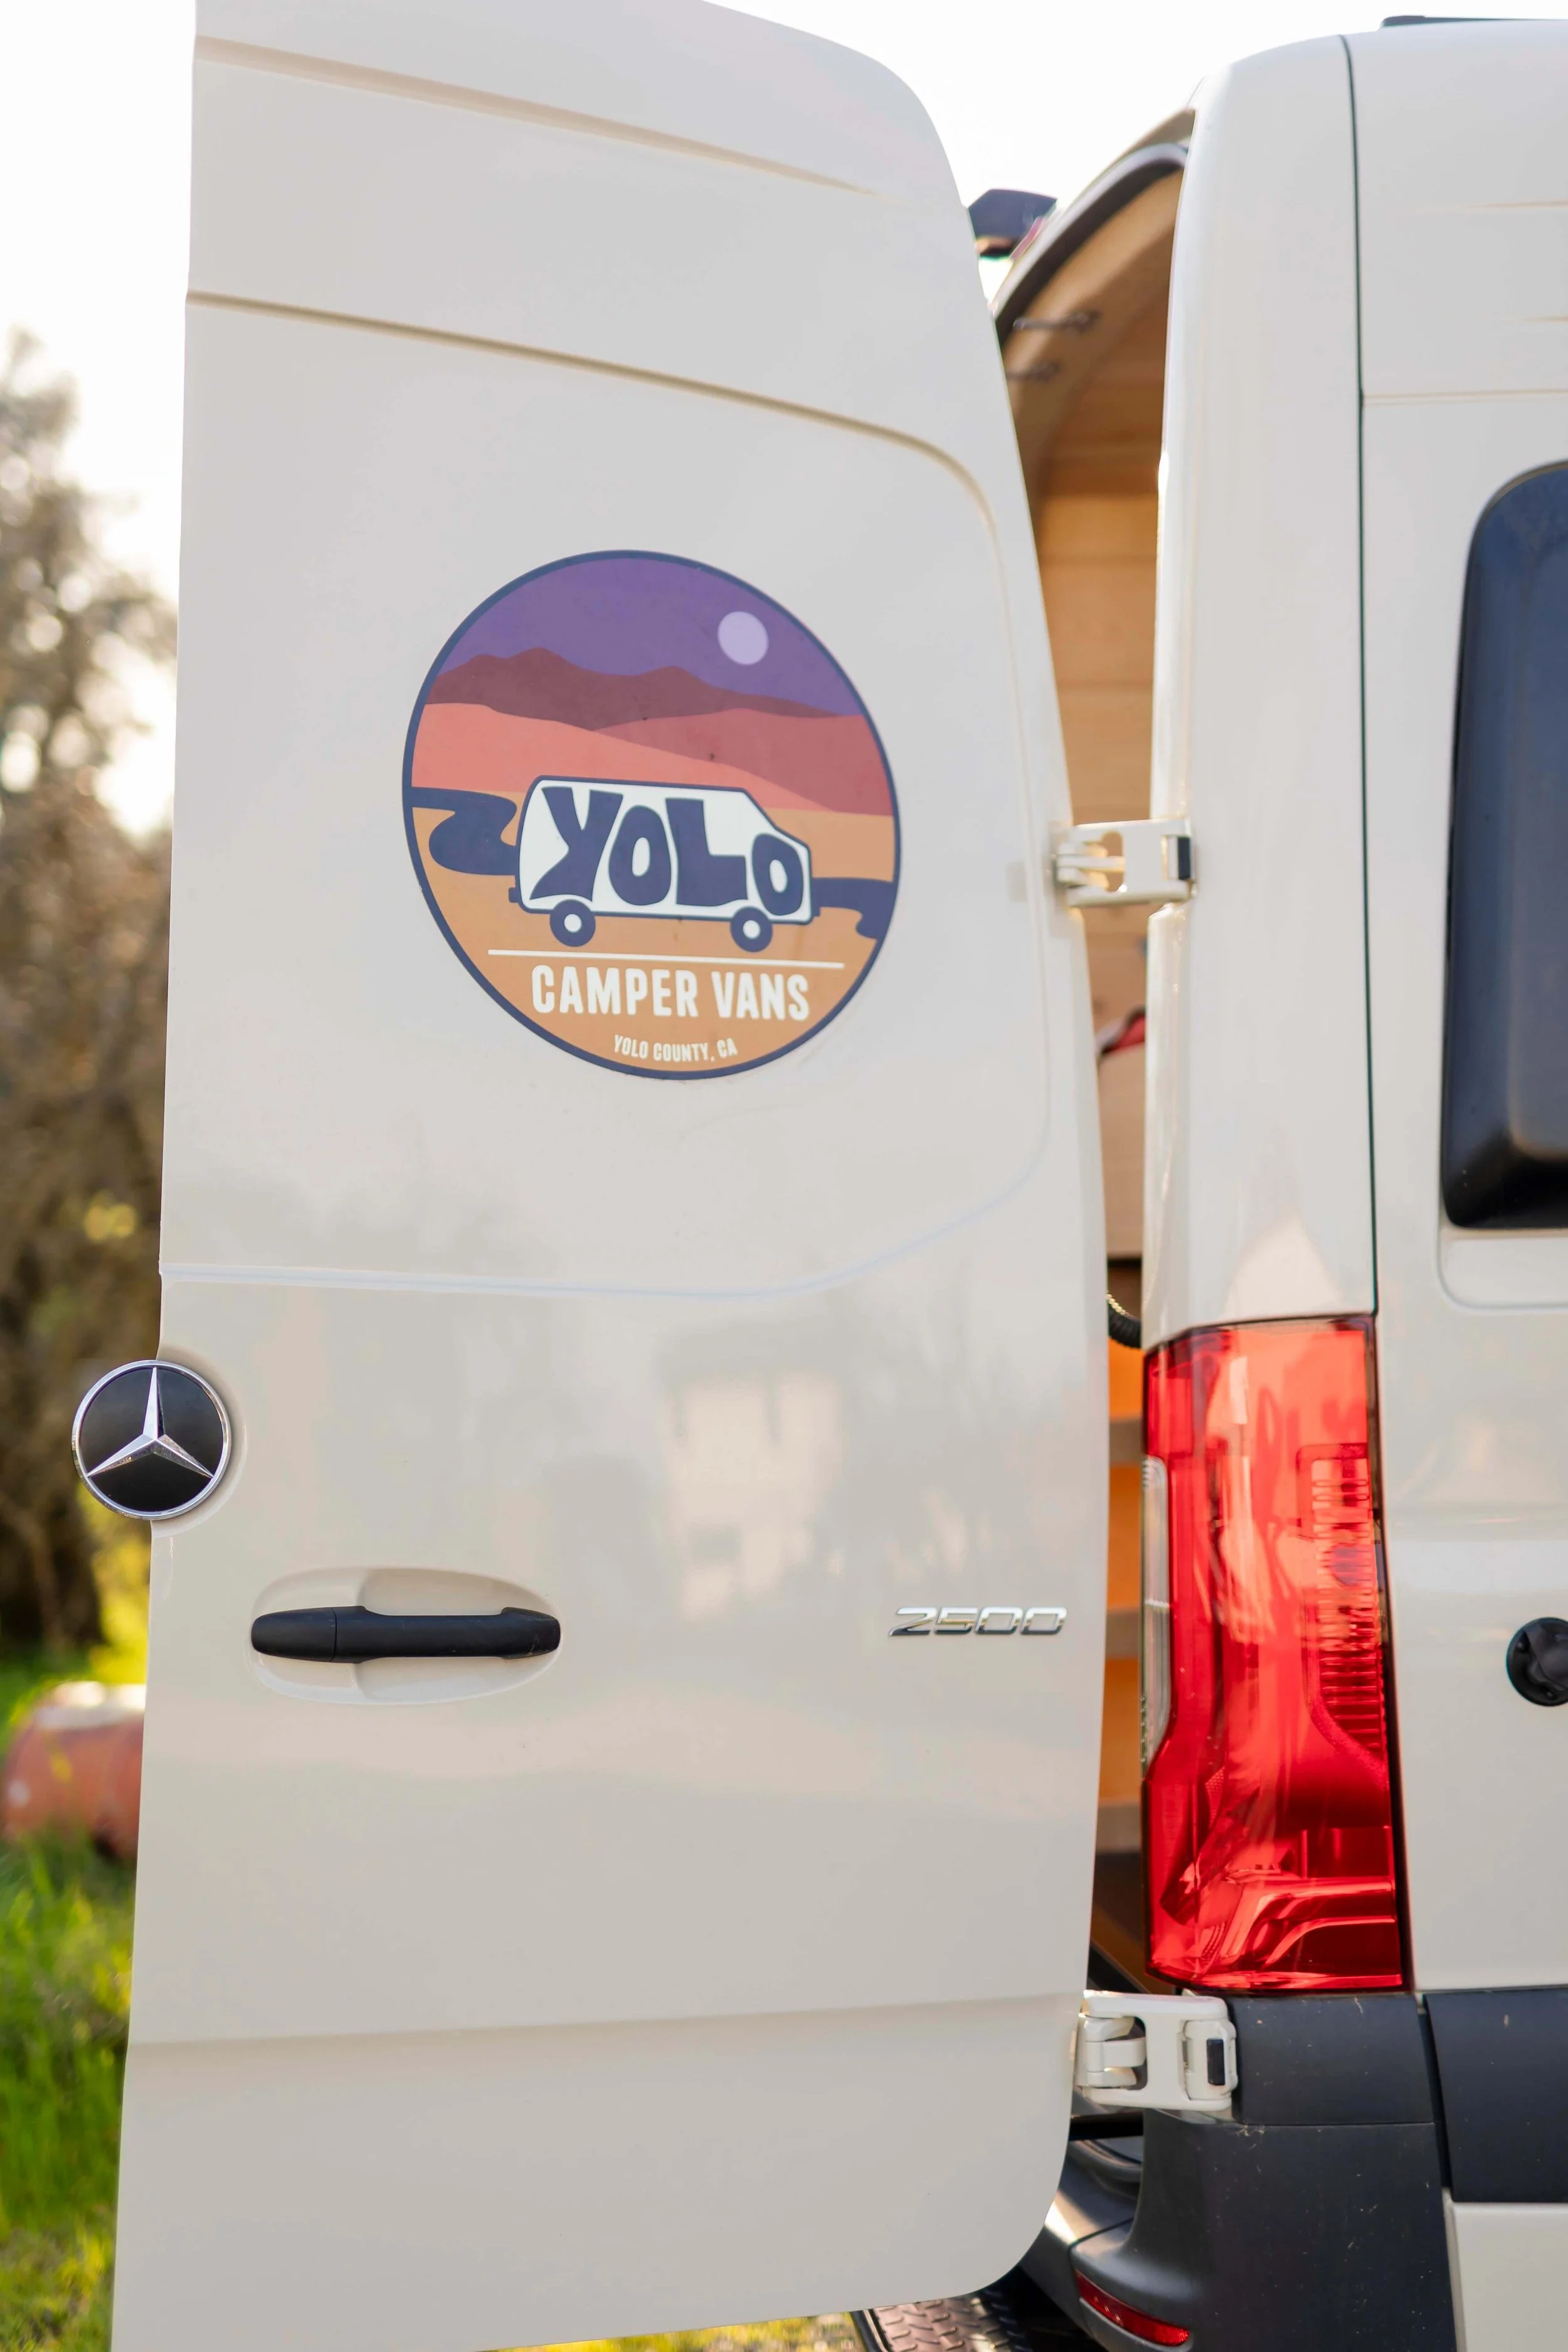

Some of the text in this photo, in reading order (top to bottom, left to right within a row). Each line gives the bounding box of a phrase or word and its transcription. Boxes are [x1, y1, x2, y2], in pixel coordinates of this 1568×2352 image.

[529, 787, 803, 916] YOLO
[532, 965, 809, 1020] CAMPER VANS
[613, 1034, 738, 1062] YOLO COUNTY, CA
[889, 1607, 1067, 1636] 2500
